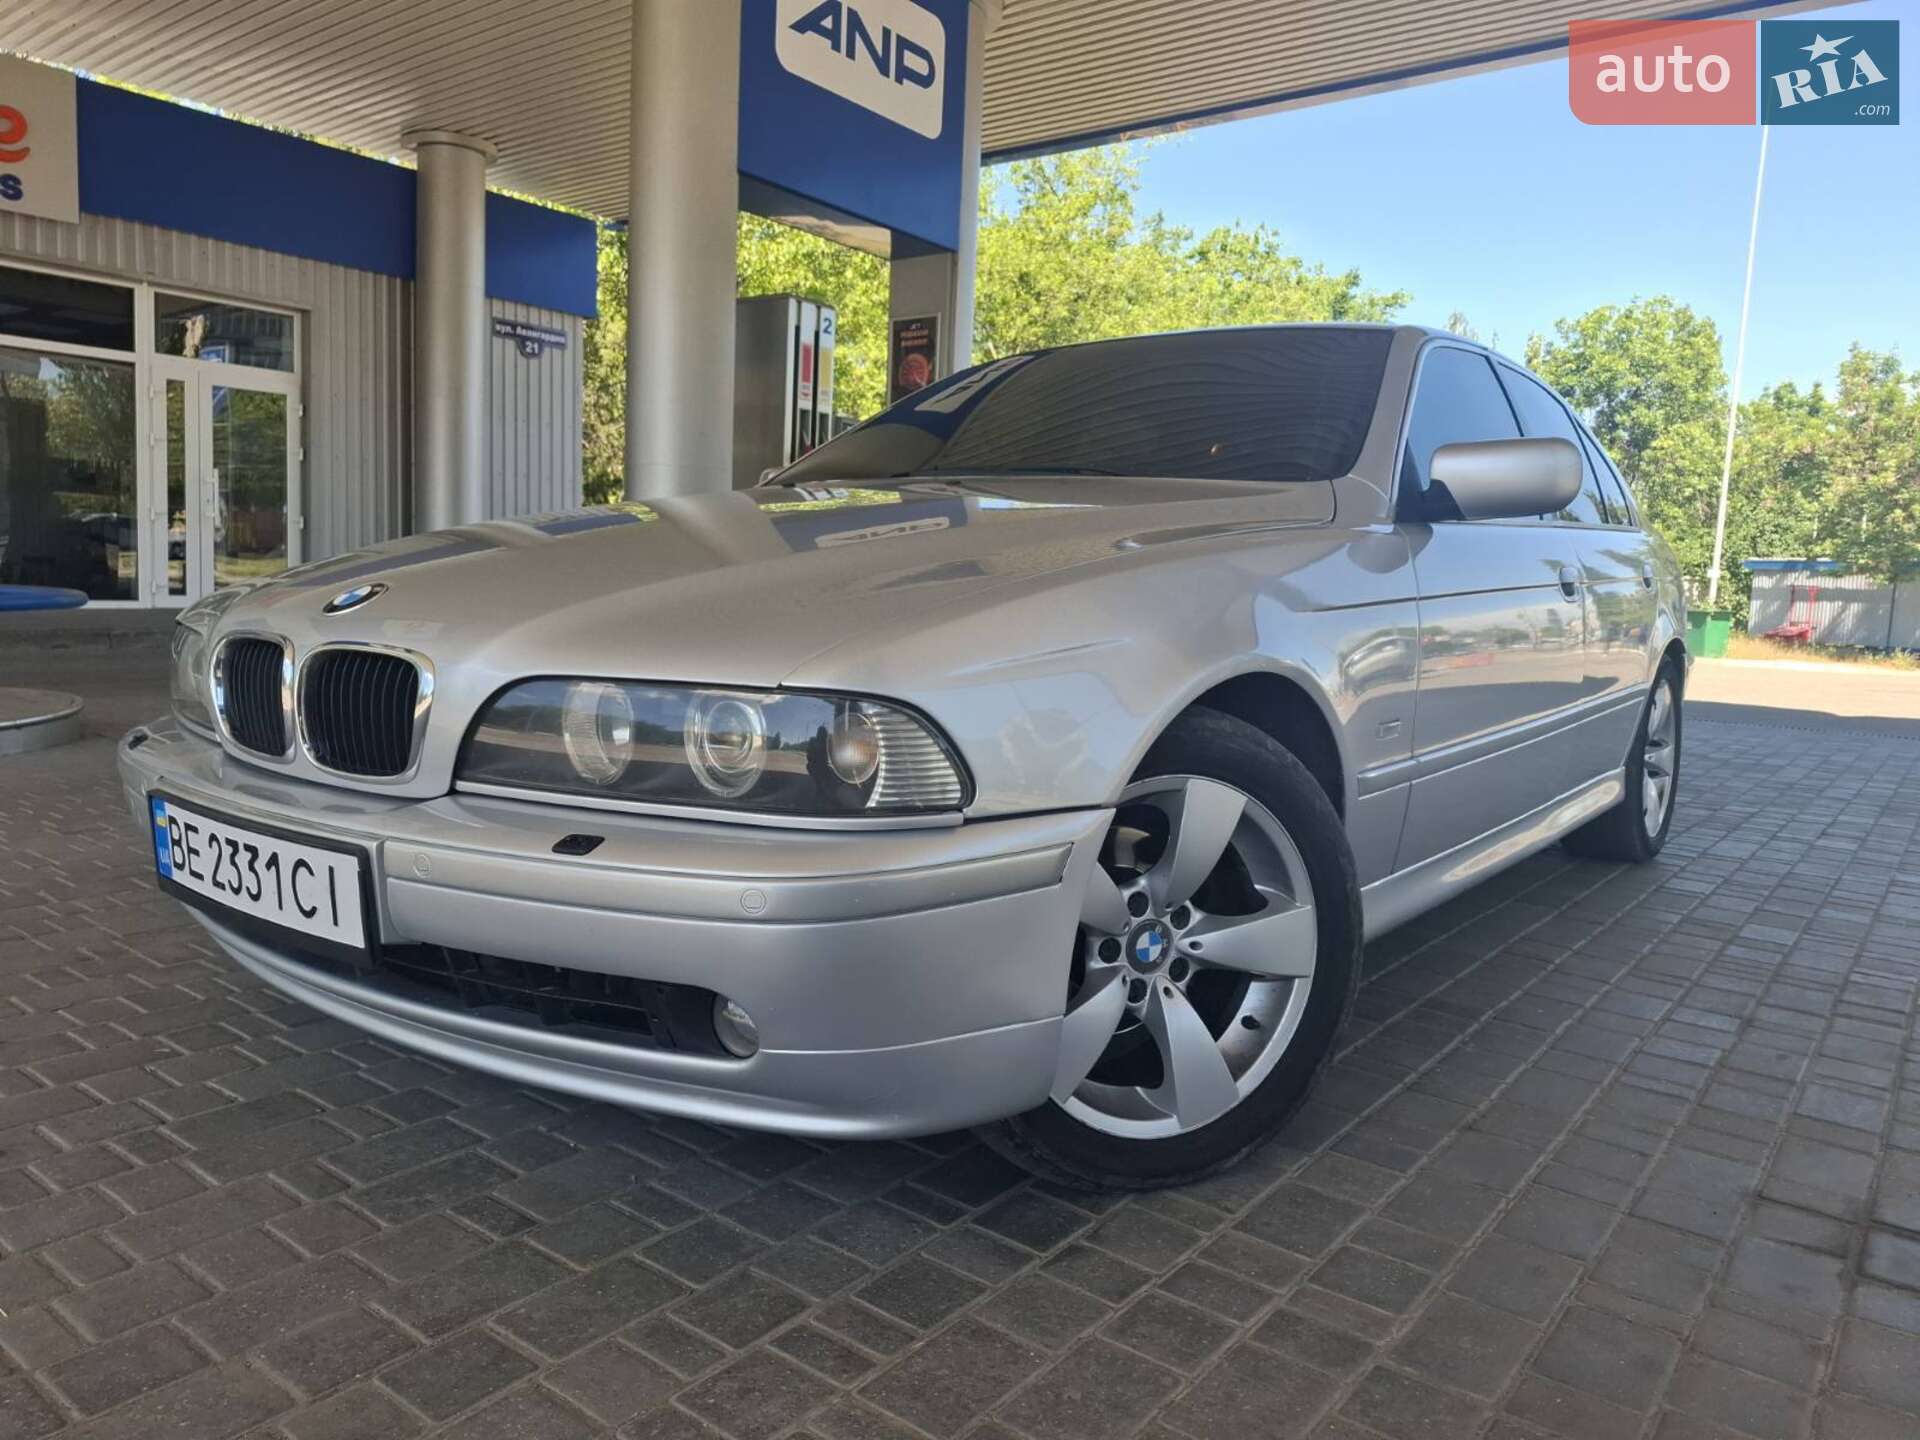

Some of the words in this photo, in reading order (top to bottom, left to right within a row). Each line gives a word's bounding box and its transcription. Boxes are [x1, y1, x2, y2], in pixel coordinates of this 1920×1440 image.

[788, 0, 936, 89] ANP
[822, 318, 832, 335] 2
[525, 341, 539, 354] 21
